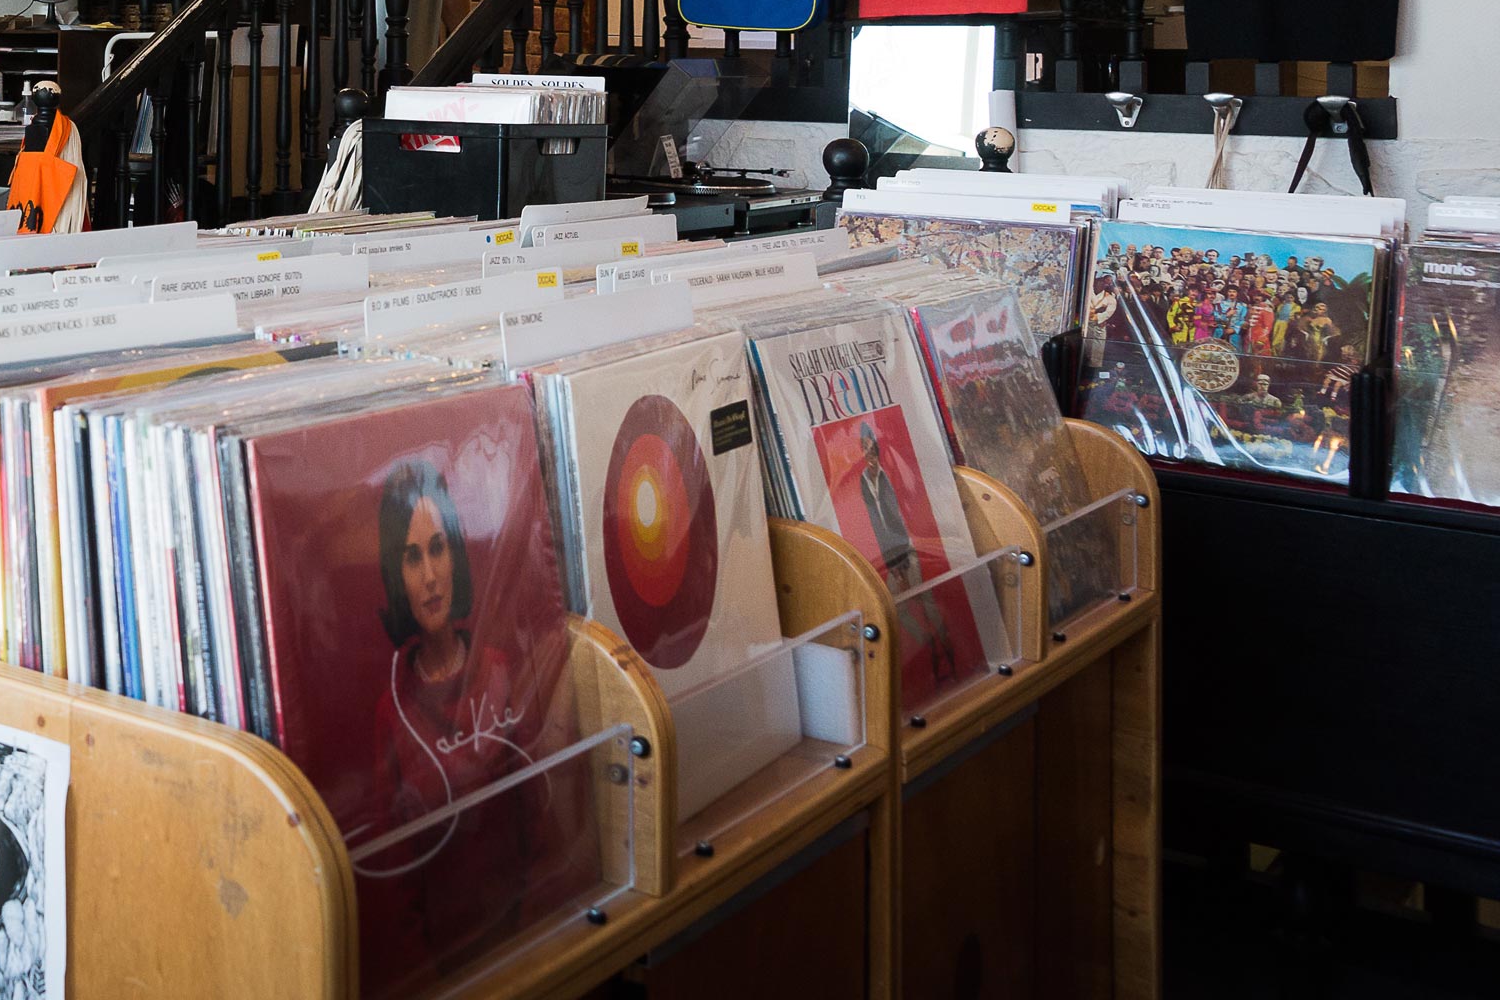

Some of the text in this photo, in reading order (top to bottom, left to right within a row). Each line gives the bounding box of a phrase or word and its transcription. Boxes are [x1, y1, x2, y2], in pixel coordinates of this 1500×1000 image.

[1033, 204, 1056, 212] OCCAZ
[496, 232, 513, 244] OCCAZ
[554, 233, 563, 241] JAZZ
[357, 247, 368, 255] JAZZ
[622, 244, 638, 254] OCCAZ
[489, 257, 500, 265] JAZZ
[600, 270, 609, 279] SUN
[617, 272, 631, 281] MILES
[632, 269, 645, 279] DAVIS
[1424, 262, 1477, 276] monks
[62, 277, 77, 285] JAZZ
[161, 282, 178, 292] RARE
[181, 280, 207, 291] GROOVE
[213, 276, 255, 288] ILLUSTRATION
[257, 273, 281, 283] SONORE
[538, 275, 556, 286] OCCAZ
[251, 286, 300, 299] LIBRARY MOOG
[392, 297, 410, 307] FILMS
[416, 288, 458, 305] SOUNDTRACKS
[465, 286, 482, 297] SERIES
[2, 304, 18, 314] AND
[22, 300, 60, 312] VAMPIRES
[64, 298, 78, 308] OST
[21, 319, 82, 336] SOUNDTRACKS
[92, 314, 117, 327] SERIES
[506, 312, 544, 326] NINA SIMONE
[789, 349, 824, 379] SARAH
[820, 341, 863, 372] VAUGHAN
[1183, 361, 1238, 373] LONELY HEARTS
